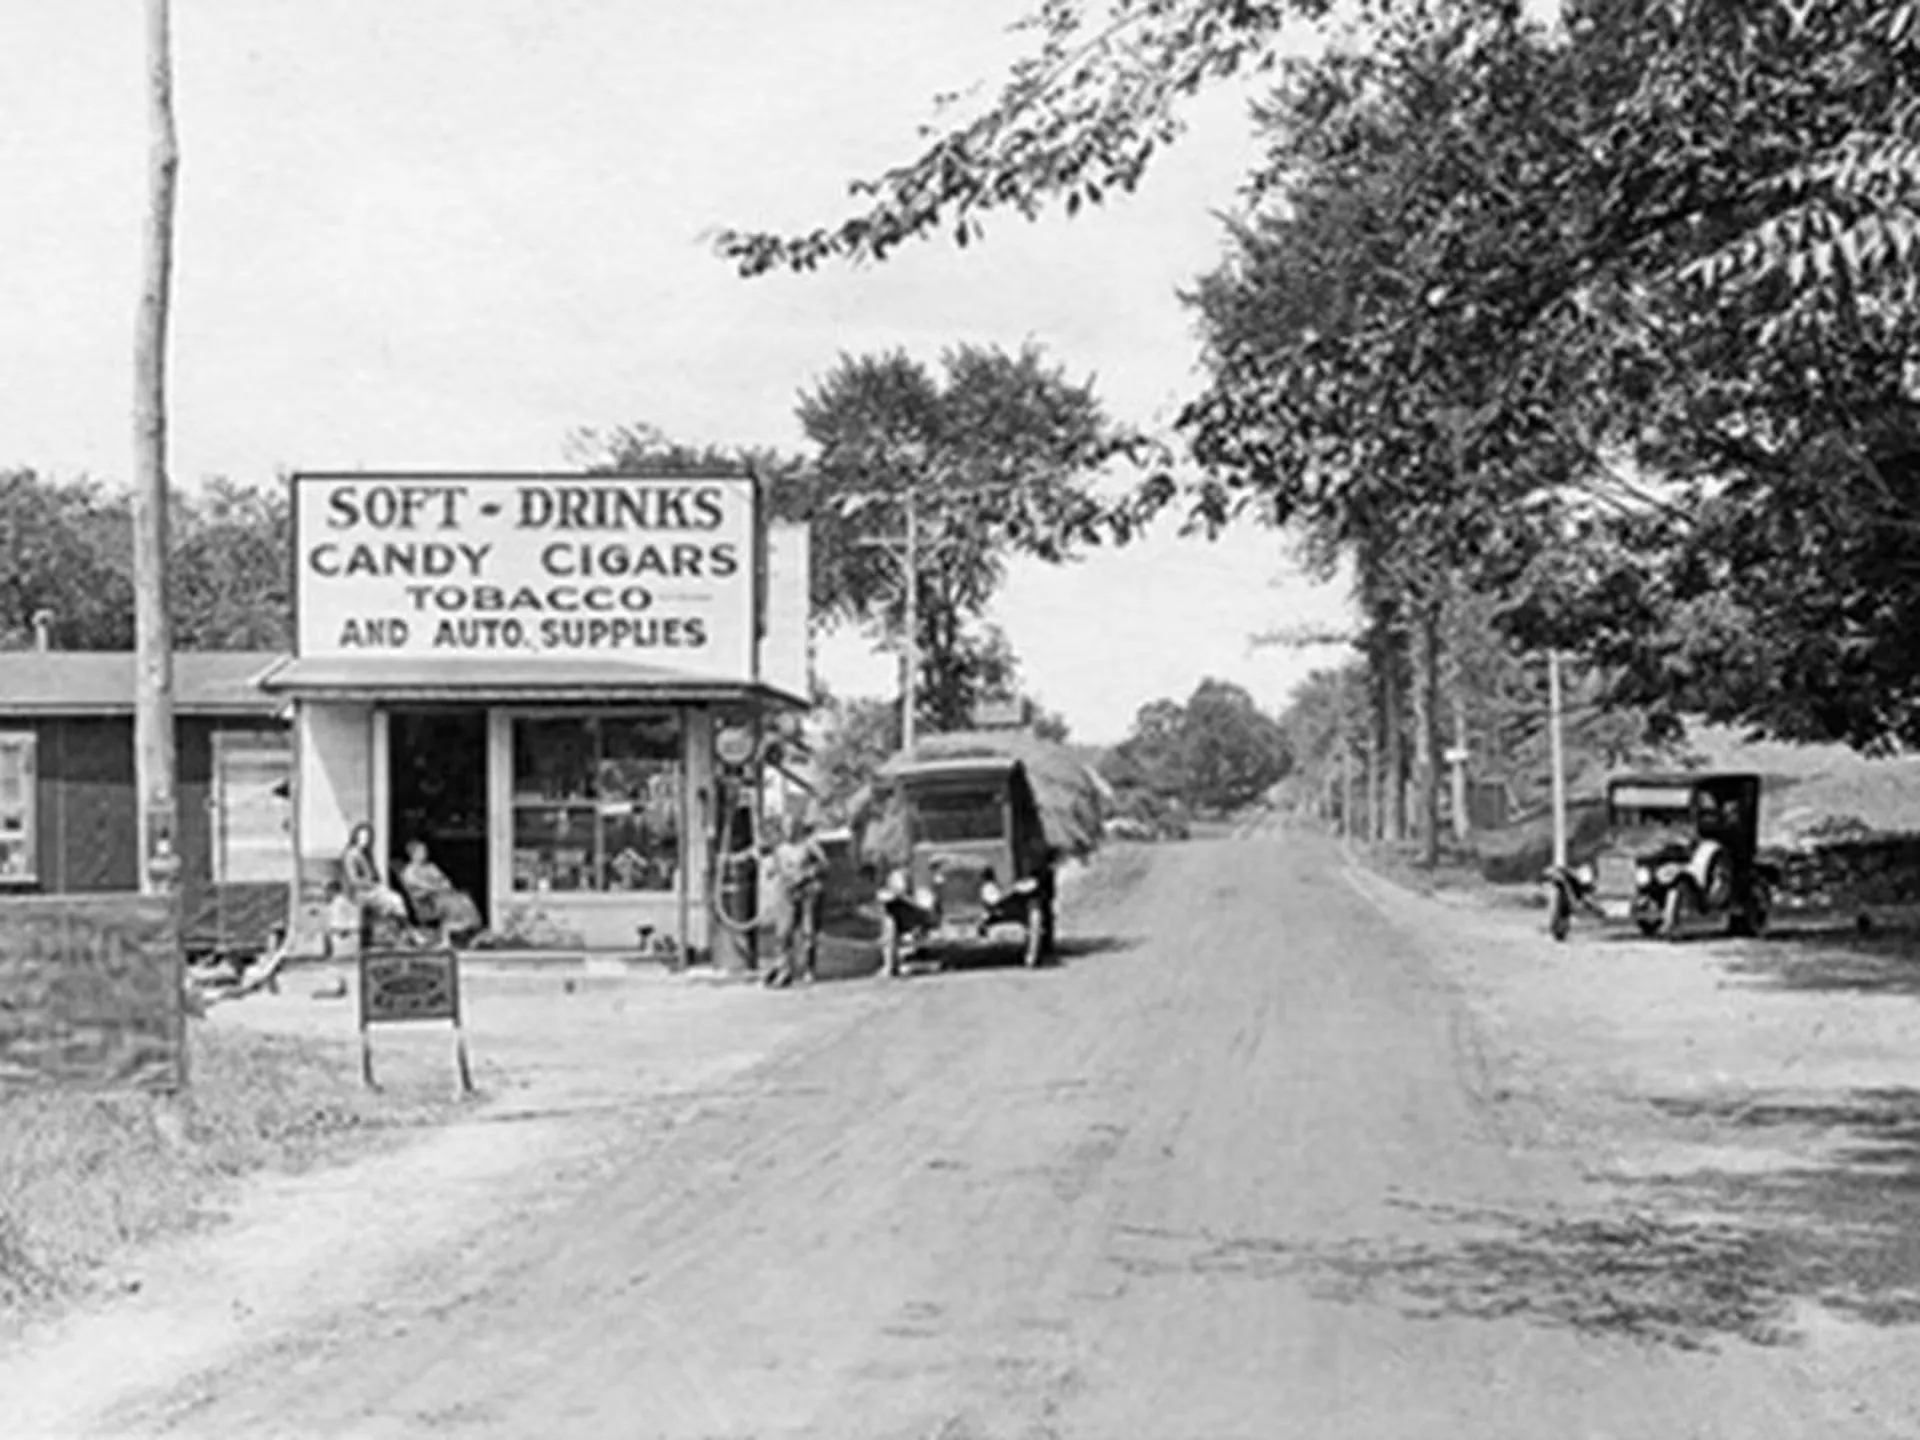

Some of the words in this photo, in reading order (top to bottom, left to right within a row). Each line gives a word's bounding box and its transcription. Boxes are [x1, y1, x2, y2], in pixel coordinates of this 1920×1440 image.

[328, 486, 468, 530] SOFT
[517, 486, 724, 530] DRINKS
[309, 543, 492, 577] CANDY
[541, 543, 739, 577] CIGARS
[406, 585, 653, 611] TOBACCO
[339, 619, 409, 648] AND
[540, 617, 708, 648] SUPPLIES
